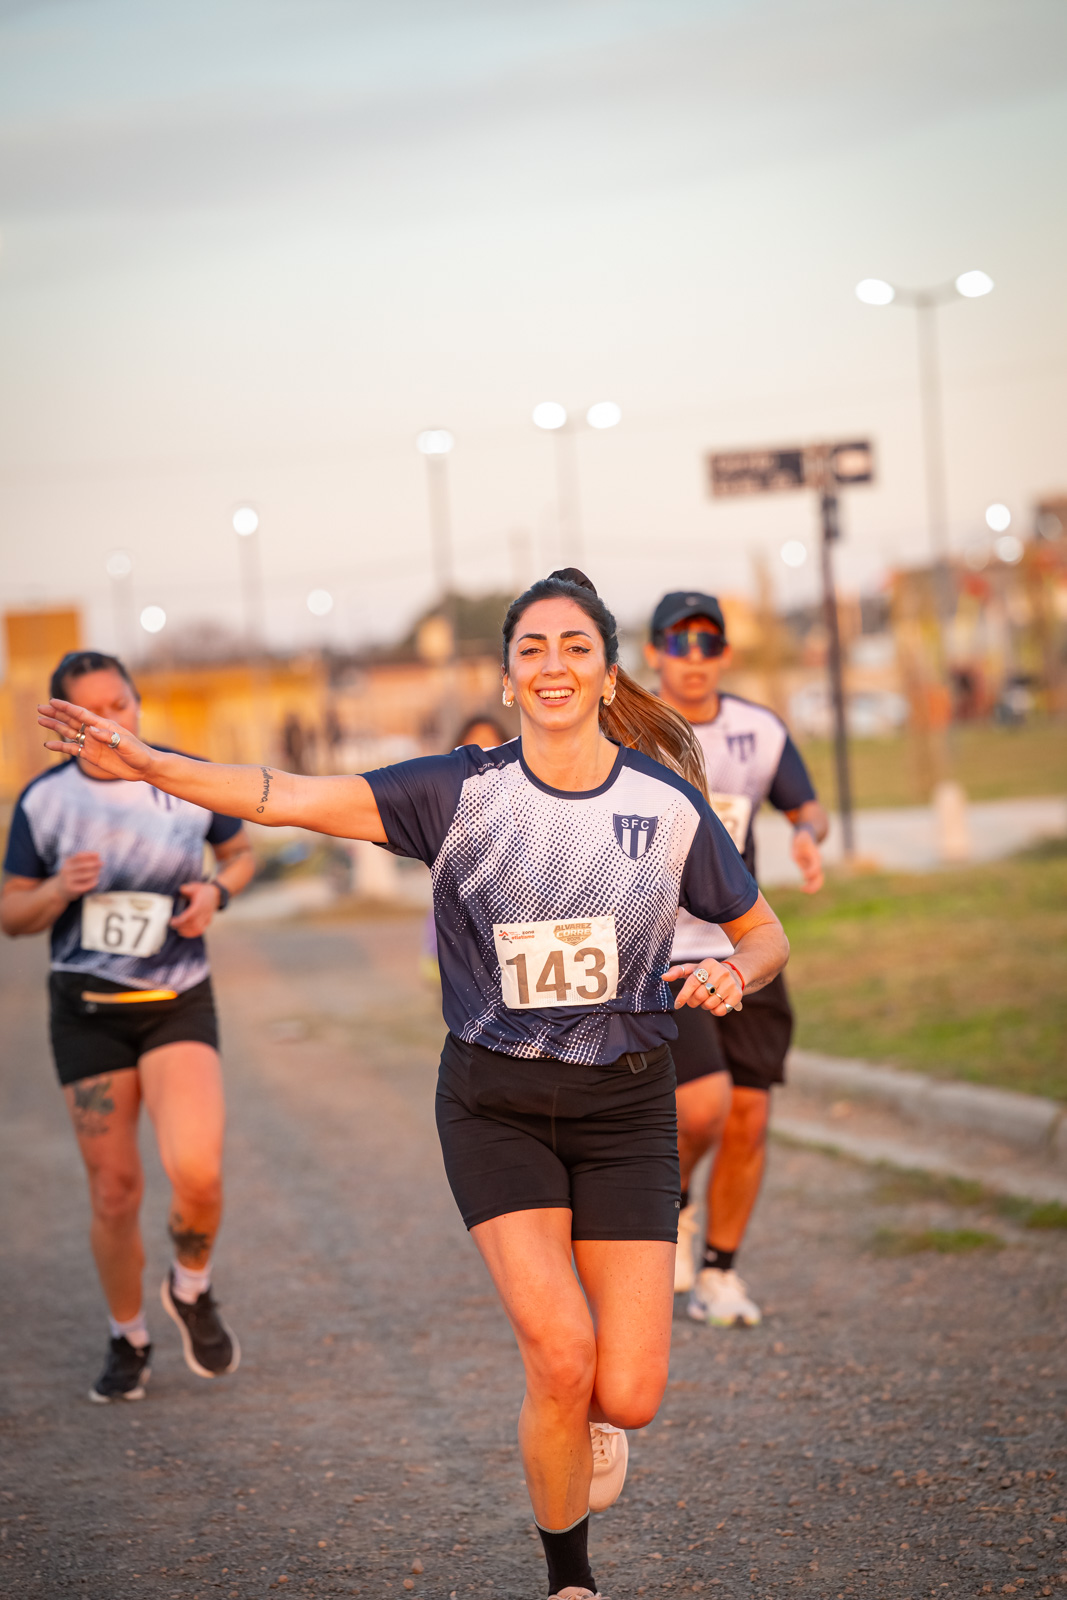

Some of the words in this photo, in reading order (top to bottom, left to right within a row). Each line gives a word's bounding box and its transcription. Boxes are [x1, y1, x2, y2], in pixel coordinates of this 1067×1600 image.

[621, 818, 649, 830] SFC
[103, 911, 150, 949] 67
[554, 923, 592, 932] ALVAREZ
[556, 929, 590, 937] CORRE
[506, 947, 608, 1004] 143
